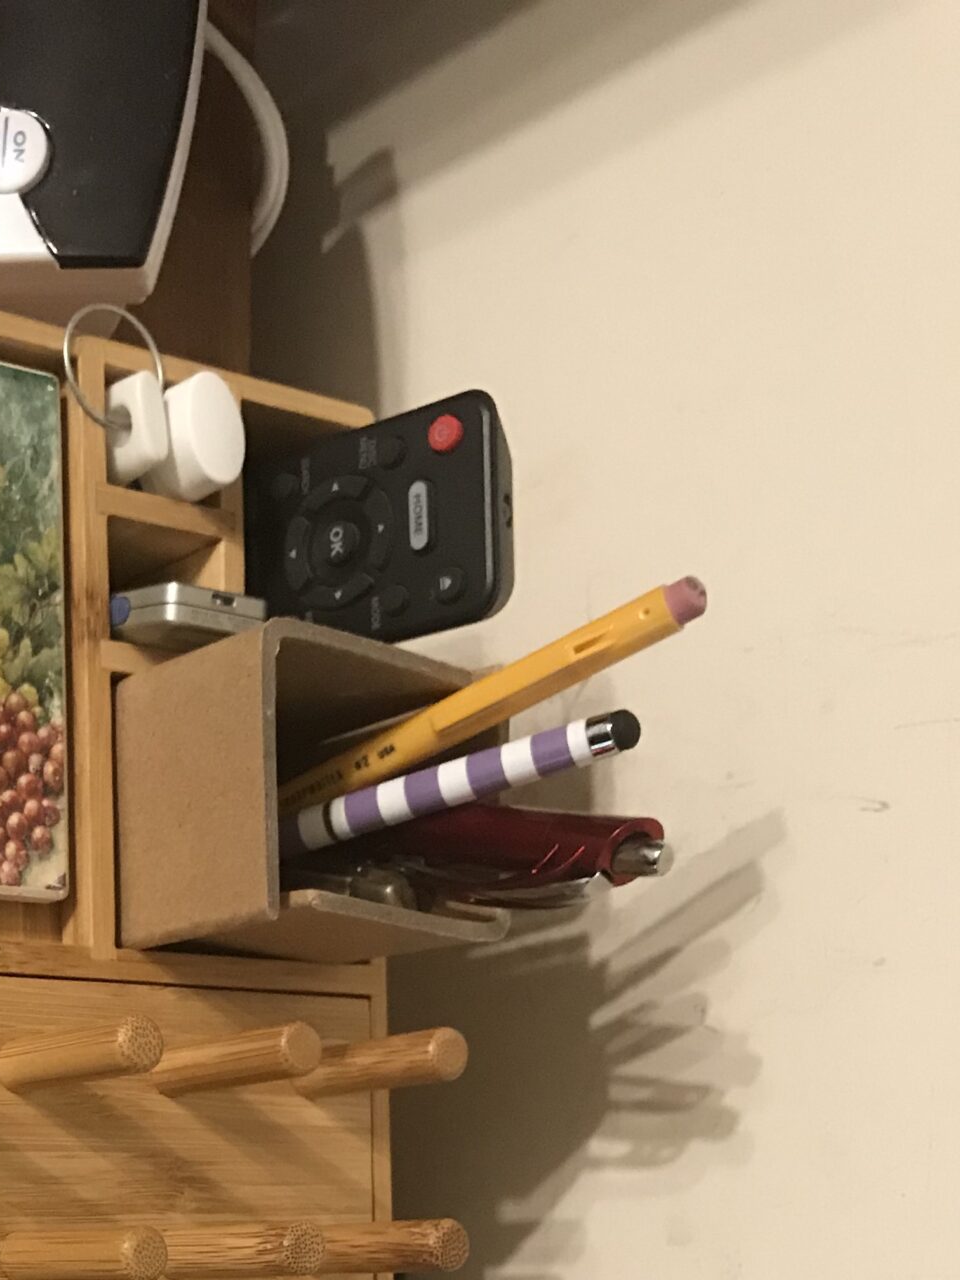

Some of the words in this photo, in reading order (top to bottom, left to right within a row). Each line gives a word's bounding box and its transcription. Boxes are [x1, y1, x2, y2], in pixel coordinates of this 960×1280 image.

[13, 130, 26, 163] ON
[413, 493, 424, 537] HOME
[330, 527, 344, 558] OK
